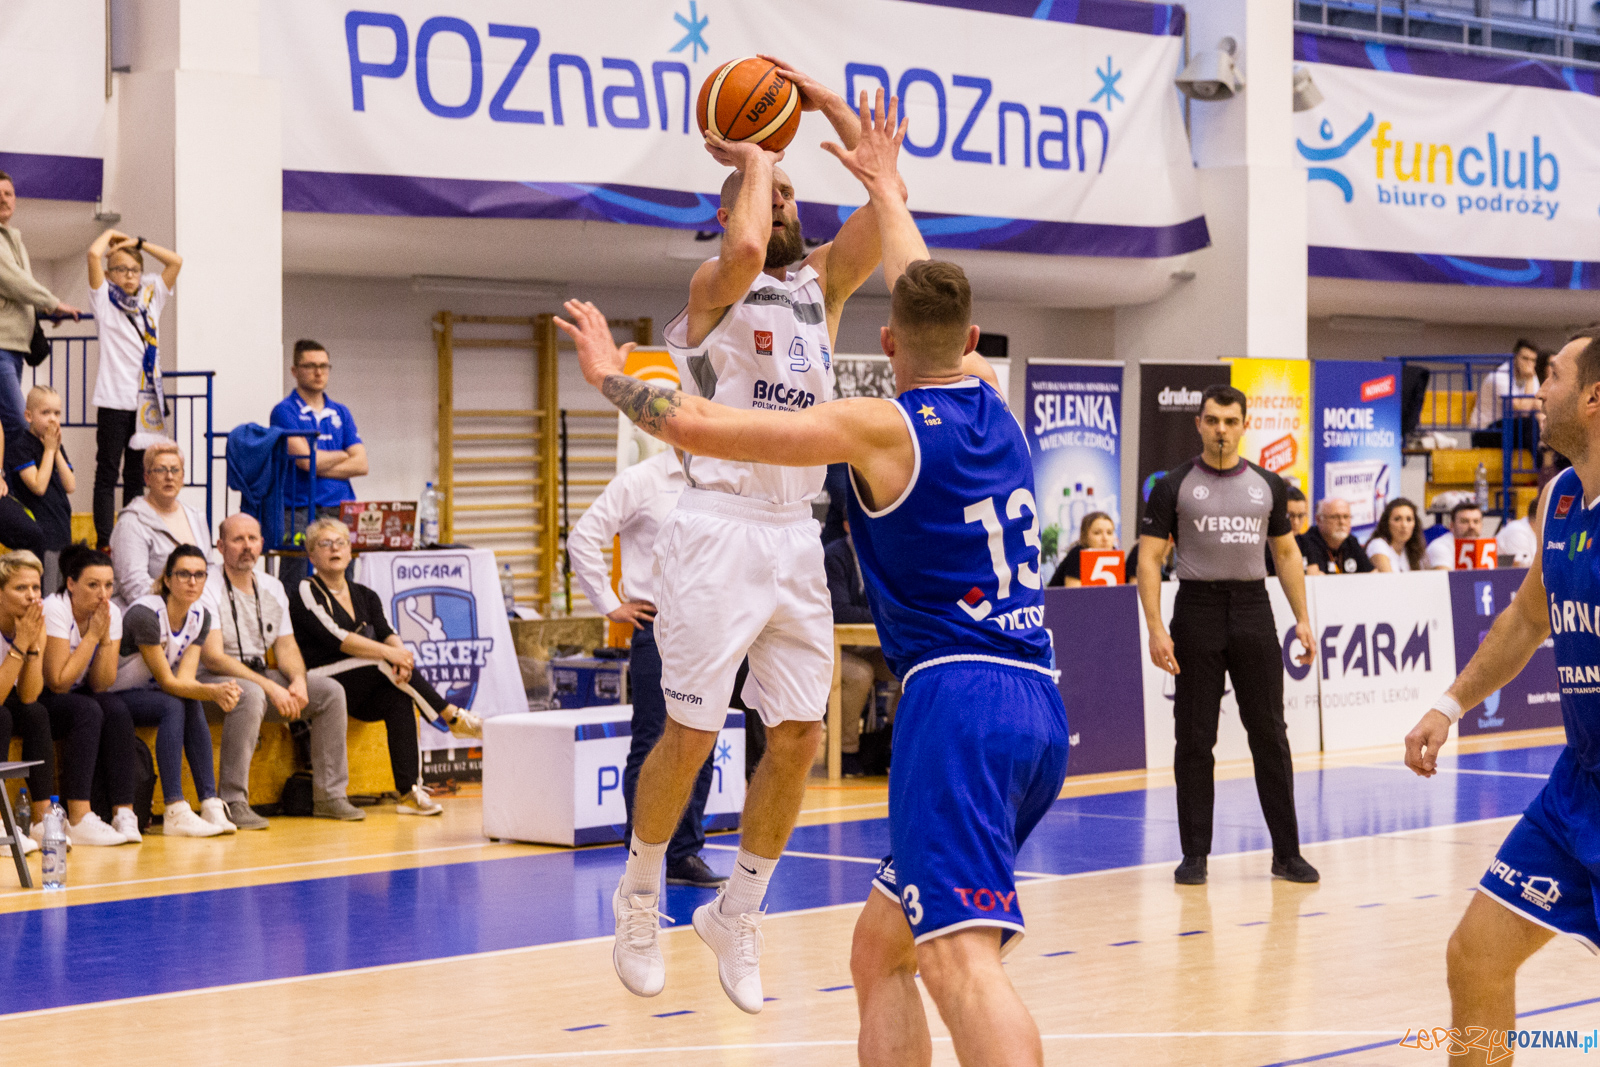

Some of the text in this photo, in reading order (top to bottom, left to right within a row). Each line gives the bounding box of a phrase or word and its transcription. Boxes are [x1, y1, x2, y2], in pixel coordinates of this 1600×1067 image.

[746, 76, 786, 123] molten
[1371, 121, 1560, 192] funclub
[1377, 184, 1560, 221] biuro podróży
[788, 335, 812, 373] 9
[753, 379, 816, 409] BIOFAR
[1158, 385, 1203, 406] drukm
[1246, 394, 1303, 409] oneczna
[924, 417, 942, 426] 1982
[1033, 394, 1118, 436] SELENKA
[1249, 412, 1300, 430] tamina
[1323, 407, 1375, 430] MOCNE
[1323, 430, 1358, 448] STAWY
[1365, 427, 1395, 448] KOŚCI
[1193, 514, 1263, 533] VERONI
[963, 487, 1042, 600] 13
[1220, 531, 1260, 545] active
[1458, 543, 1496, 570] 5 5
[397, 564, 463, 579] BIOFARM
[1090, 556, 1120, 587] 5
[987, 604, 1045, 631] VICTO
[1551, 592, 1600, 638] ÓRN
[404, 641, 494, 666] ASKET
[1283, 619, 1432, 681] OFARM
[420, 665, 471, 682] OZNAŃ
[1557, 665, 1600, 684] TRAN
[1574, 686, 1600, 694] TRANSPO
[468, 760, 483, 770] KLU
[901, 884, 923, 926] 3
[954, 888, 1021, 913] TOY
